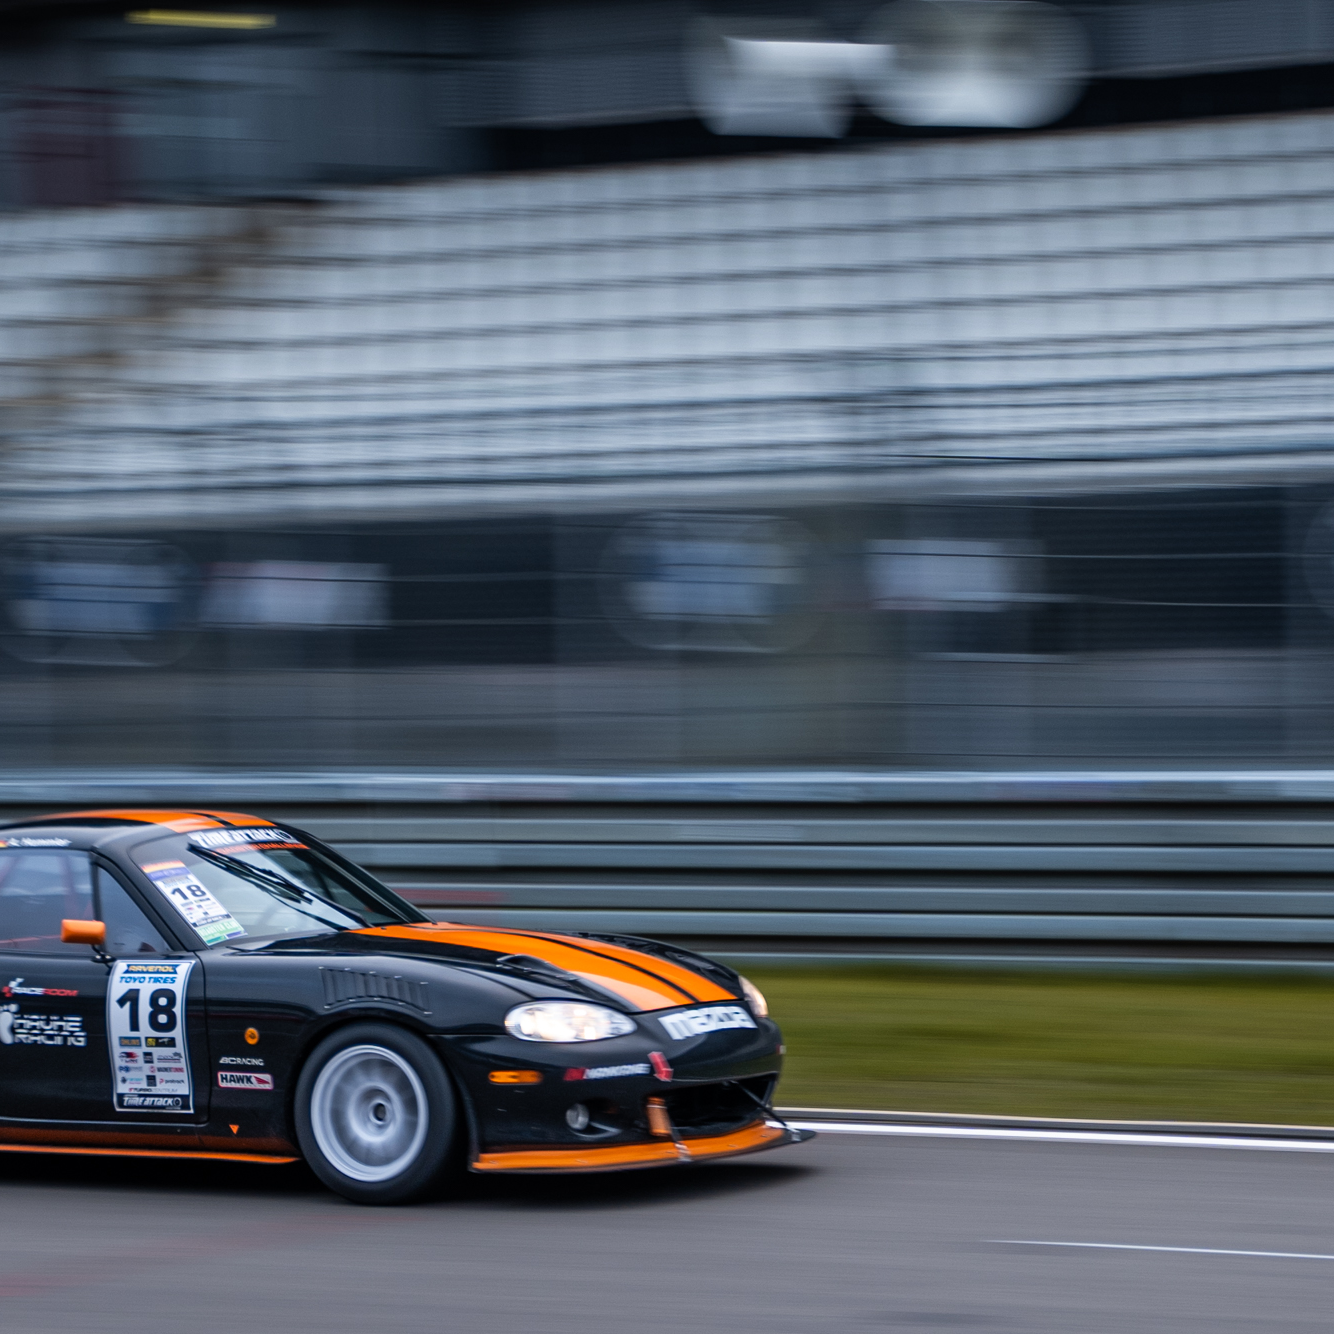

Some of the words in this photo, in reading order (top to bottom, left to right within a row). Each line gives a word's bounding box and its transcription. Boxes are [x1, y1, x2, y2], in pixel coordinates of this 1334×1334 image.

[170, 884, 207, 900] 18
[119, 976, 146, 984] TOYO
[147, 976, 178, 984] TIRES
[115, 988, 178, 1034] 18
[219, 1073, 254, 1085] HAWK
